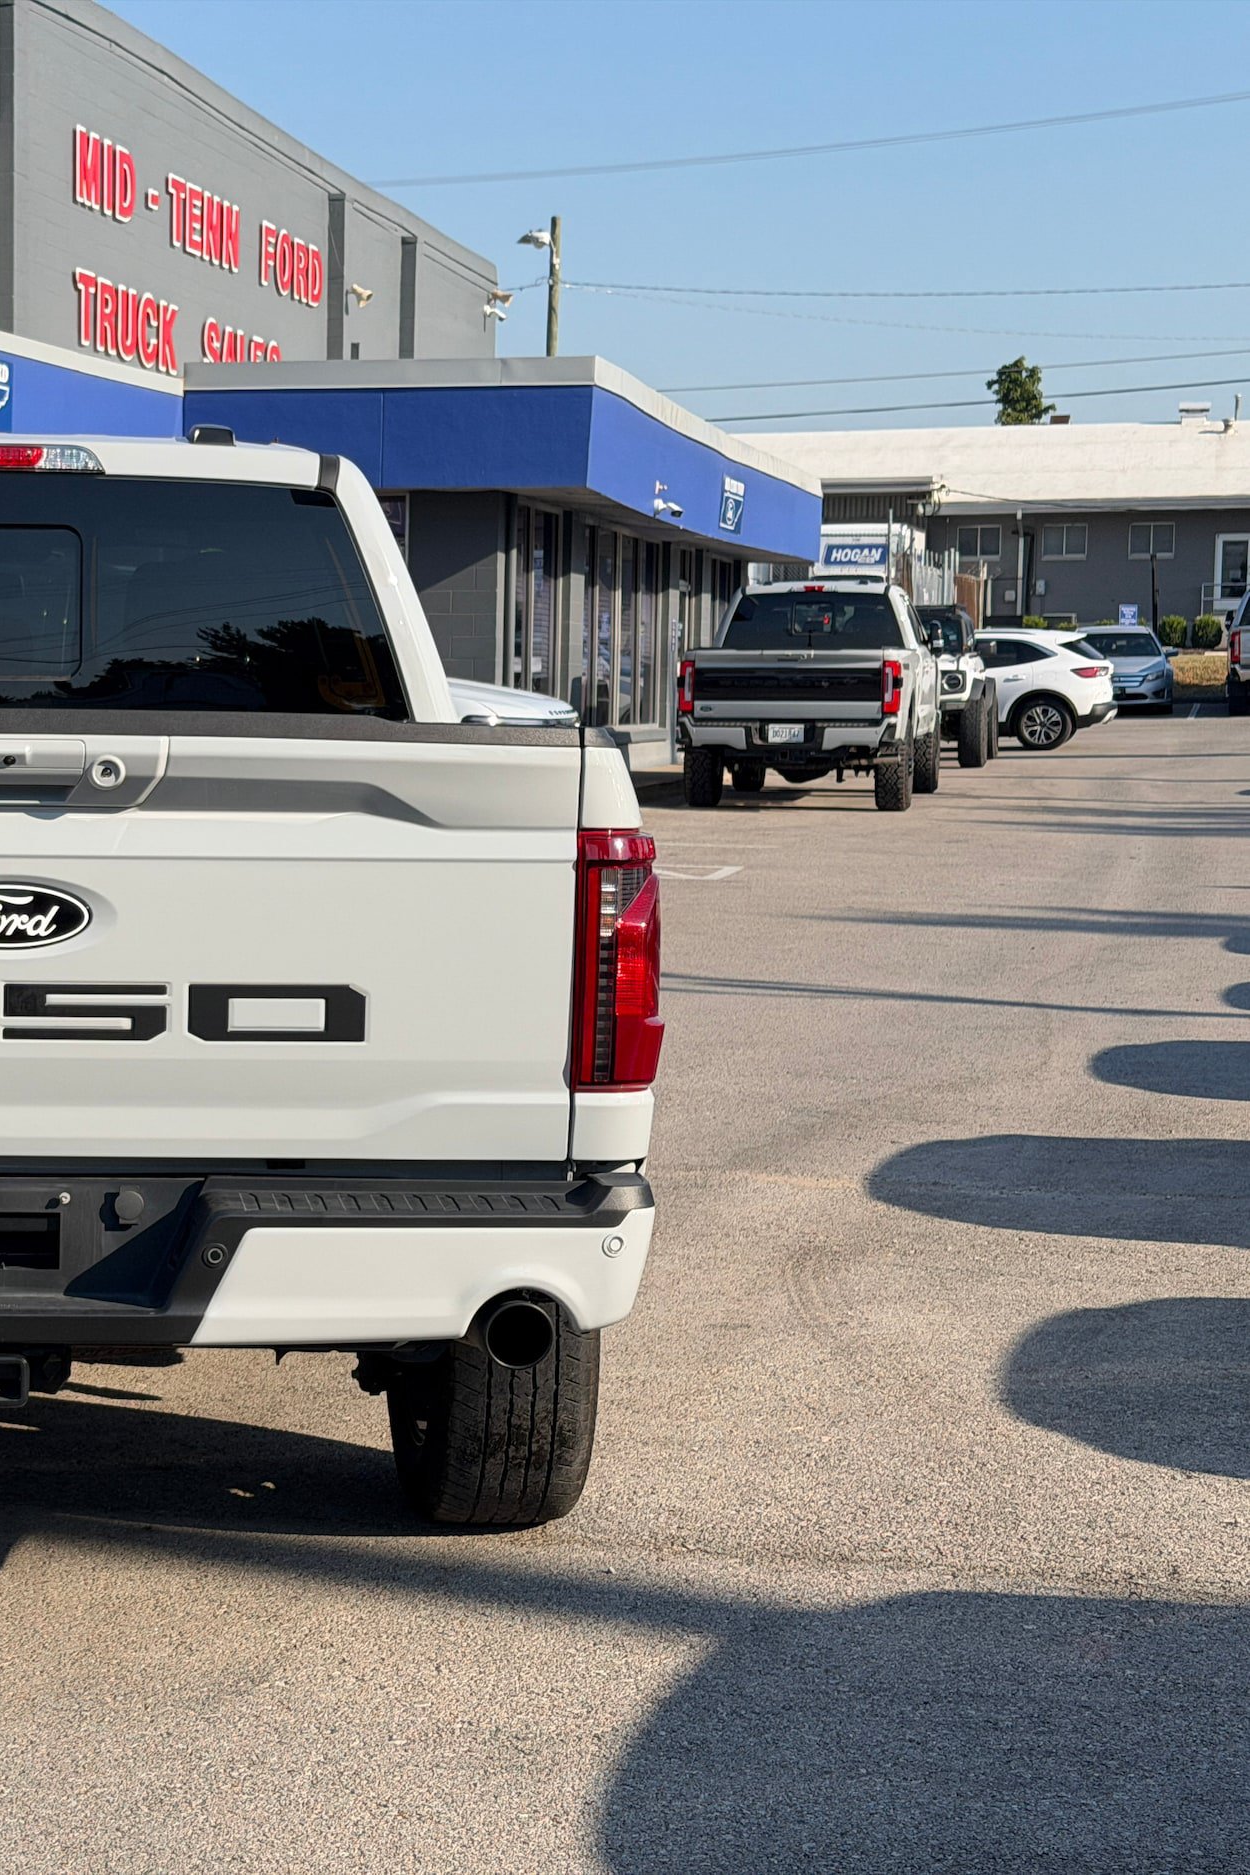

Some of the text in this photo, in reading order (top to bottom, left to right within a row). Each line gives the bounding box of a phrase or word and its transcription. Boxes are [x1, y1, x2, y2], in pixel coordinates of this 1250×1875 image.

[74, 123, 137, 223] MID
[168, 172, 241, 274] TENN
[260, 219, 324, 308] FORD
[75, 267, 180, 376] TRUCK
[831, 547, 883, 563] HOGAN
